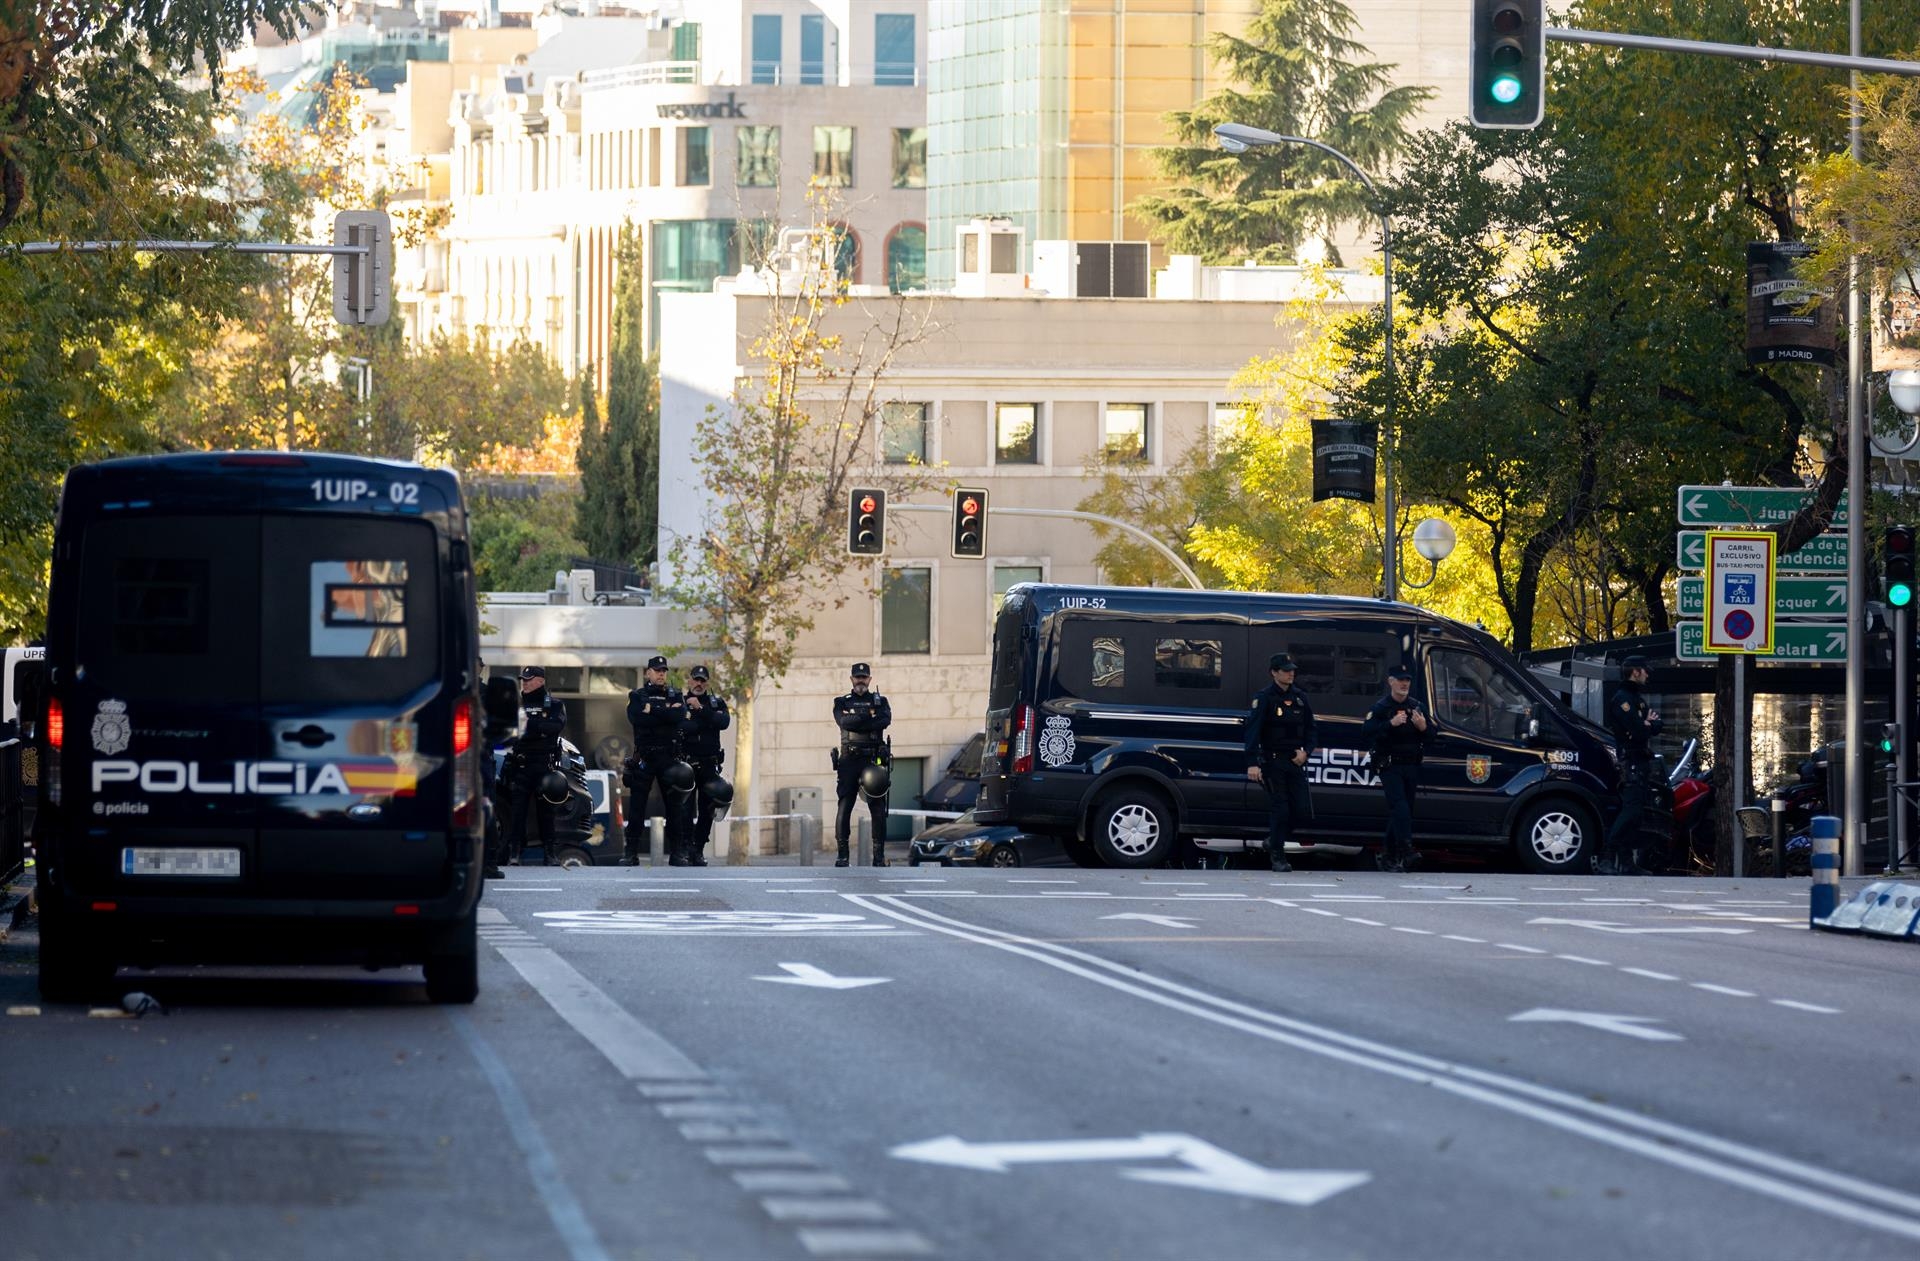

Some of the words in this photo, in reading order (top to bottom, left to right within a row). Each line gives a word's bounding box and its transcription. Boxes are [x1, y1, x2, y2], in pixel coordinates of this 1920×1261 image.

[1778, 350, 1813, 359] MADRID
[311, 479, 377, 501] 1UIP-
[389, 482, 419, 504] 02
[1336, 490, 1361, 498] MADRID
[1818, 540, 1833, 550] de
[1836, 540, 1847, 550] la
[1776, 552, 1847, 565] endencia
[1059, 597, 1106, 609] 1UIP-52
[1777, 599, 1818, 610] cquer
[1560, 751, 1579, 762] 091
